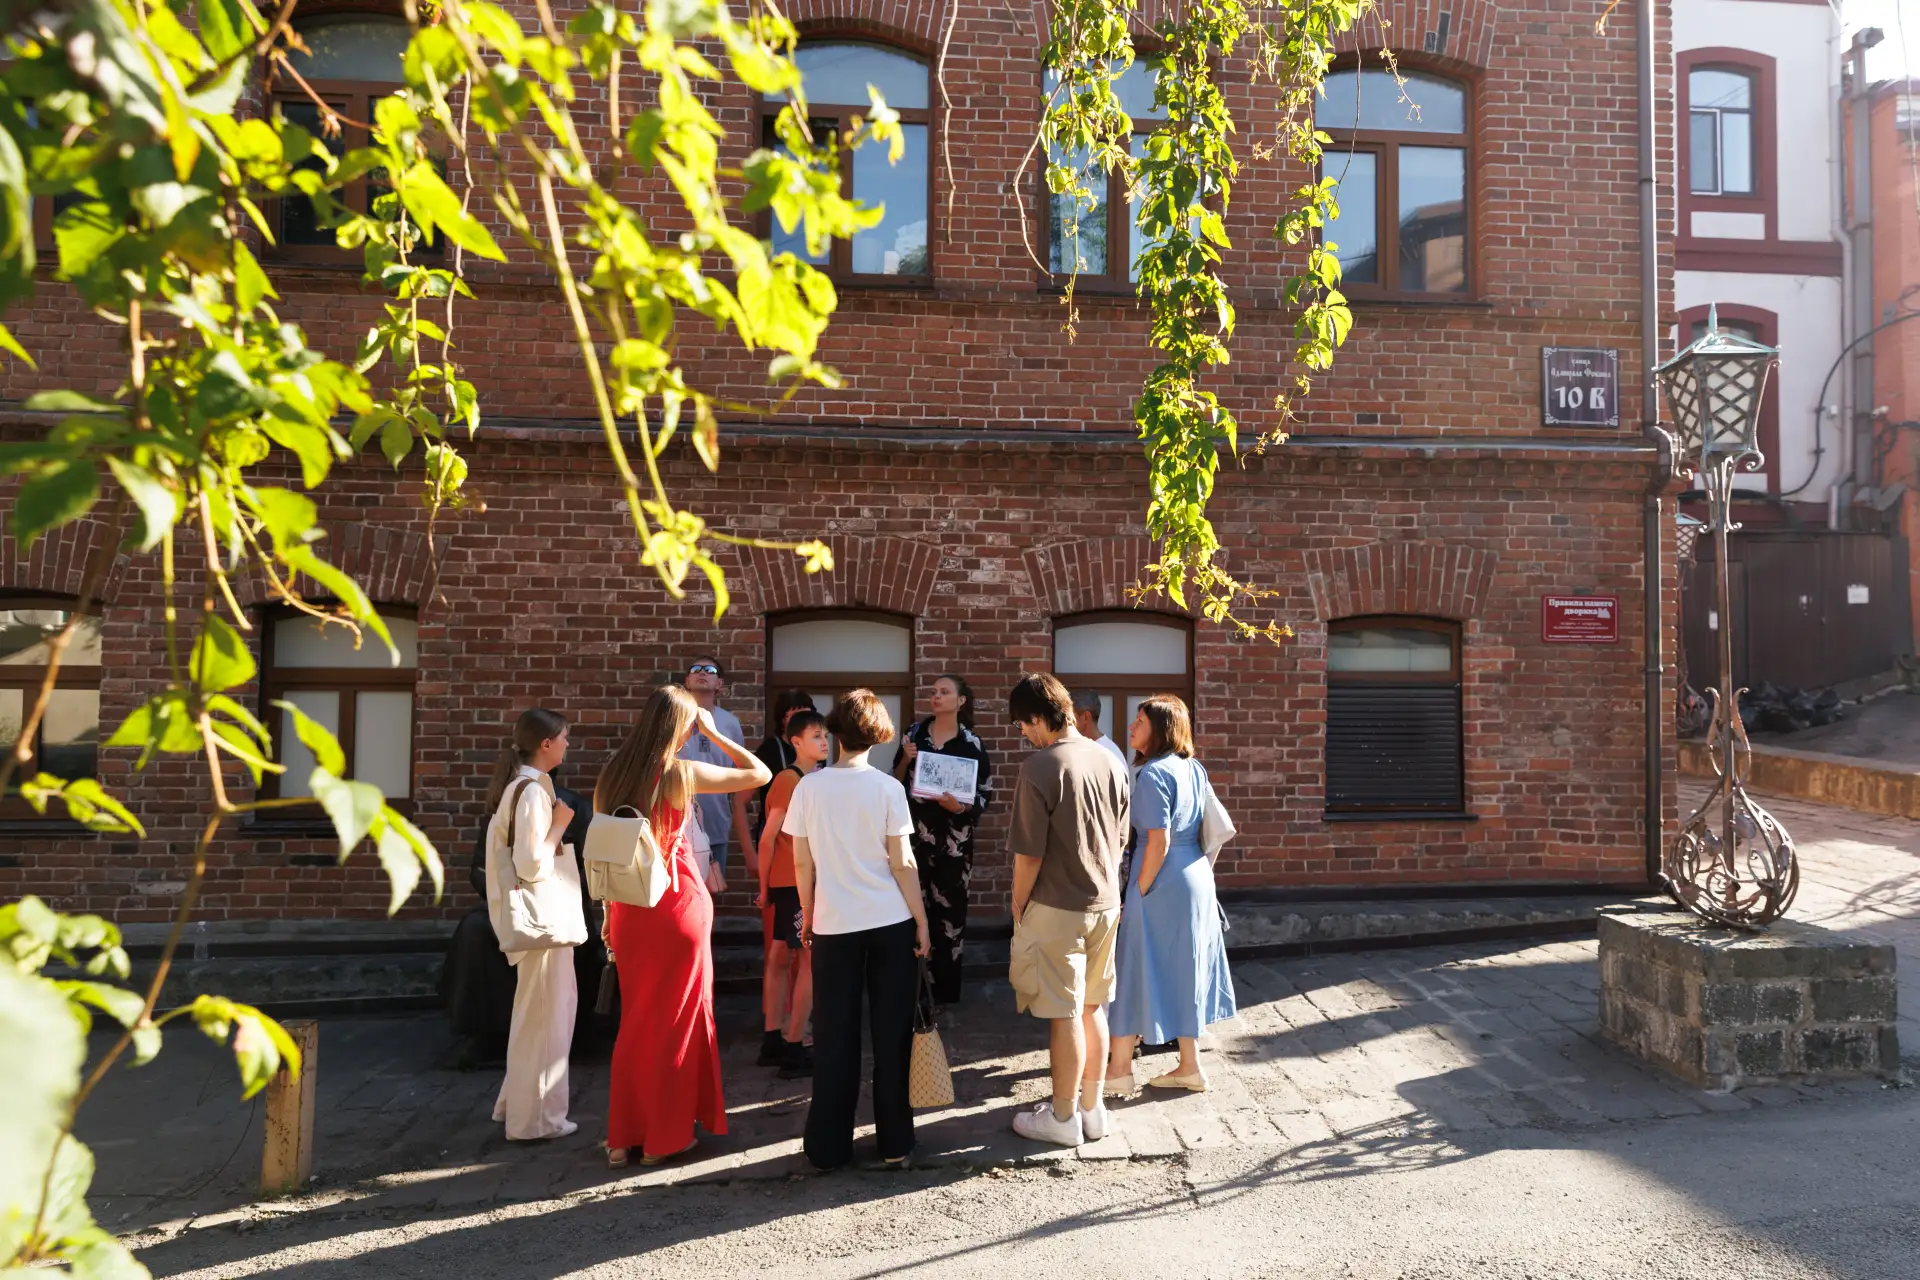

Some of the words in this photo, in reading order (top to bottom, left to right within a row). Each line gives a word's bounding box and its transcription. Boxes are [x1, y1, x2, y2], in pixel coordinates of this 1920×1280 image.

[1554, 386, 1583, 409] 10
[1548, 598, 1583, 608] Правила
[1564, 608, 1598, 616] дворика
